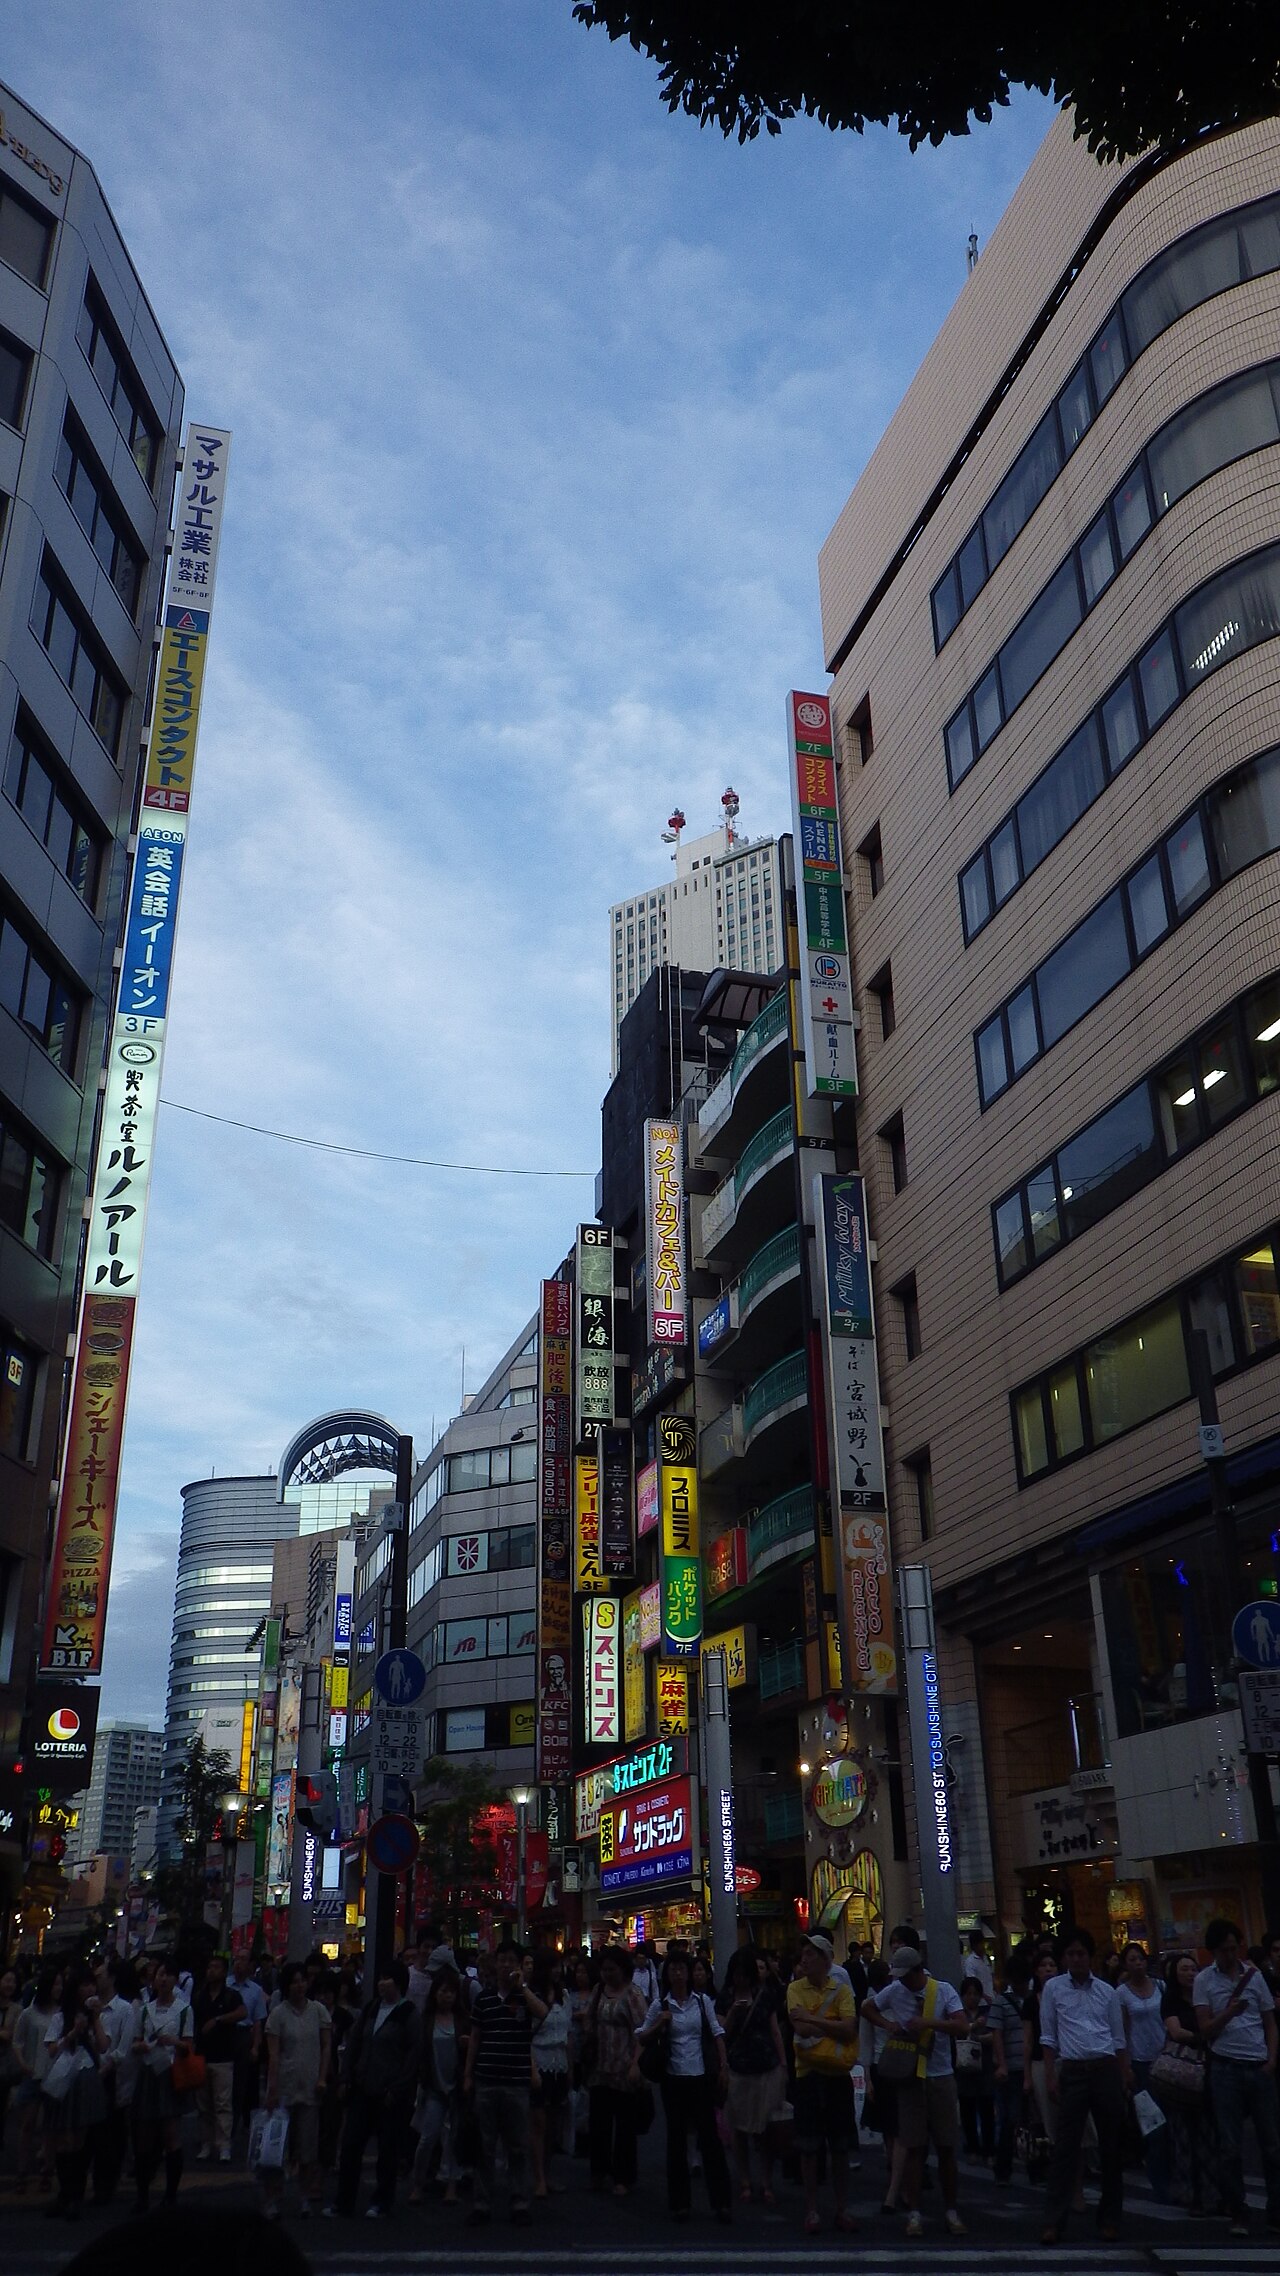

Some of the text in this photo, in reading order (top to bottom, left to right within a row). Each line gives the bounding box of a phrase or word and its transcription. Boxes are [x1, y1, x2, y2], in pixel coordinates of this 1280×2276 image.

[181, 435, 223, 556] マサル工業
[156, 631, 200, 786] エースコンタクト
[806, 742, 821, 753] 7F
[804, 757, 816, 803] コンタクト
[147, 790, 187, 809] 4F
[810, 806, 826, 816] 6F
[144, 829, 183, 842] AEON
[804, 825, 816, 858] スクール
[814, 870, 830, 881] 5F
[131, 846, 173, 1010] 英会話 イーオン
[818, 938, 835, 949] 4F
[124, 1017, 158, 1034] 3F
[827, 1024, 840, 1079] 献血ルーム
[828, 1081, 845, 1092] 3F
[120, 1069, 144, 1142] 喫茶室
[651, 1126, 680, 1141] No.1
[809, 1139, 828, 1148] 5F
[95, 1145, 146, 1288] ルノアール
[834, 1194, 855, 1243] Way
[654, 1145, 682, 1310] メイドカフェ&バー
[583, 1230, 609, 1245] 6F
[838, 1245, 858, 1305] Milky
[654, 1318, 683, 1338] 5F
[843, 1318, 860, 1333] 2F
[10, 1361, 22, 1379] 3F
[584, 1365, 610, 1378] 飲放
[846, 1379, 868, 1450] 宮城野
[584, 1422, 608, 1438] 27
[71, 1392, 112, 1532] シェーキーズ
[853, 1492, 872, 1506] 2F
[672, 1477, 691, 1551] プロミス
[62, 1566, 101, 1579] PIZZA
[612, 1562, 626, 1571] 7F
[582, 1581, 603, 1591] 3F
[683, 1566, 698, 1621] ポケット
[667, 1581, 682, 1626] バンク
[596, 1601, 615, 1630] S
[453, 1636, 477, 1655] JTB
[676, 1644, 693, 1654] 7F
[51, 1649, 94, 1668] B1F
[658, 1666, 687, 1678] フリー
[924, 1653, 937, 1683] CITY
[594, 1635, 616, 1737] スピンズ
[544, 1701, 569, 1710] KFC
[660, 1679, 687, 1718] 麻雀
[1254, 1690, 1262, 1703] 8
[928, 1683, 943, 1749] SUNSHINE
[1255, 1705, 1269, 1718] 12
[381, 1722, 387, 1732] 8
[407, 1723, 417, 1734] 10
[659, 1718, 689, 1736] さん
[34, 1742, 88, 1752] LOTTERIA
[380, 1734, 390, 1746] 12
[403, 1735, 417, 1747] 22
[378, 1760, 389, 1771] 10
[401, 1761, 416, 1773] 22
[931, 1752, 944, 1770] TO
[932, 1772, 945, 1787] ST
[720, 1789, 732, 1827] STREET
[633, 1807, 686, 1853] サンドラッグ
